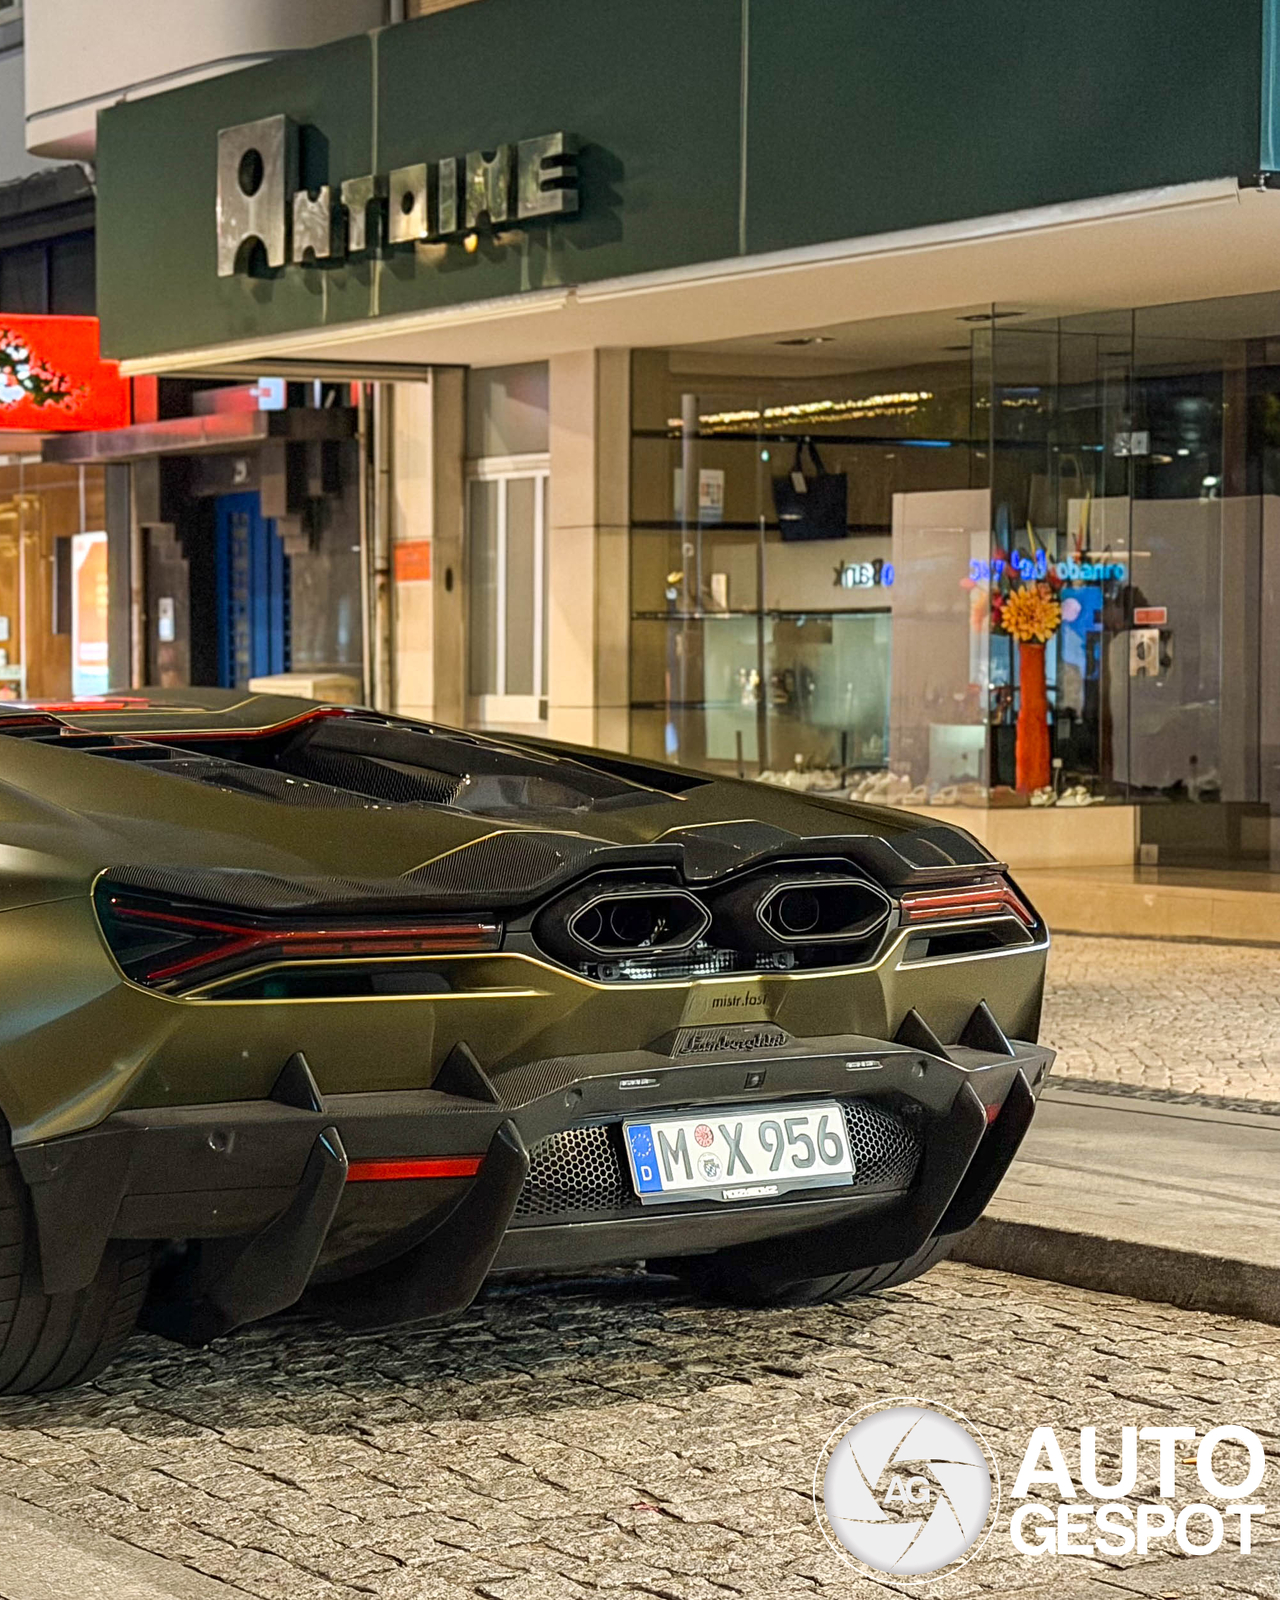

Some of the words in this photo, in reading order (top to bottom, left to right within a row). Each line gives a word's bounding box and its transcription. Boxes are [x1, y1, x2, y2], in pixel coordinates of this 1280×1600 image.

[657, 1128, 694, 1183] M
[718, 1122, 754, 1177] X
[758, 1115, 845, 1172] 956
[640, 1165, 653, 1182] D
